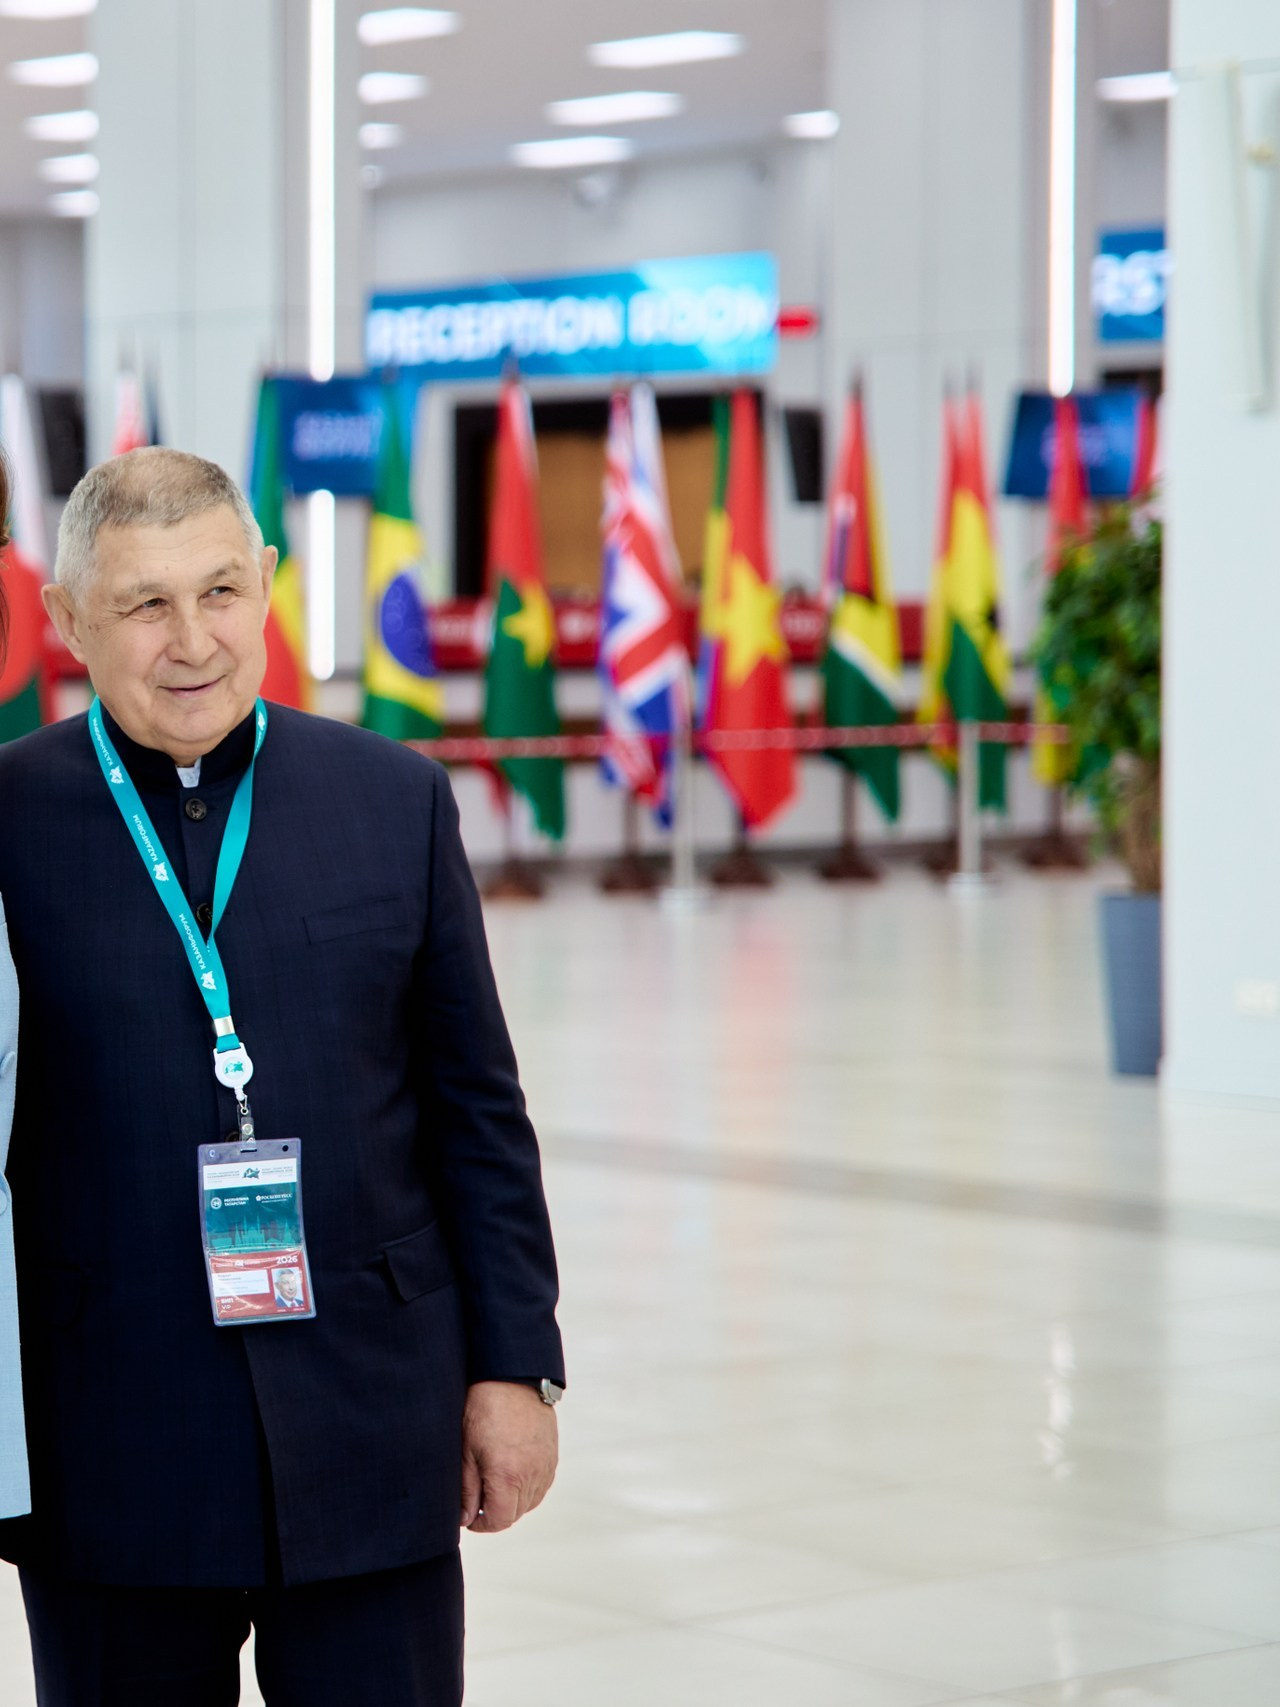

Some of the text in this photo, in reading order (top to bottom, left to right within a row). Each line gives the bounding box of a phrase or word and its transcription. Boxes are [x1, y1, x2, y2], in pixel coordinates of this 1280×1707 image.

[367, 296, 625, 366] RECEPTION
[132, 814, 158, 862] KAZANFORUM
[179, 913, 206, 970] КАЗАНЬФОРУМ
[276, 1255, 298, 1264] 2026
